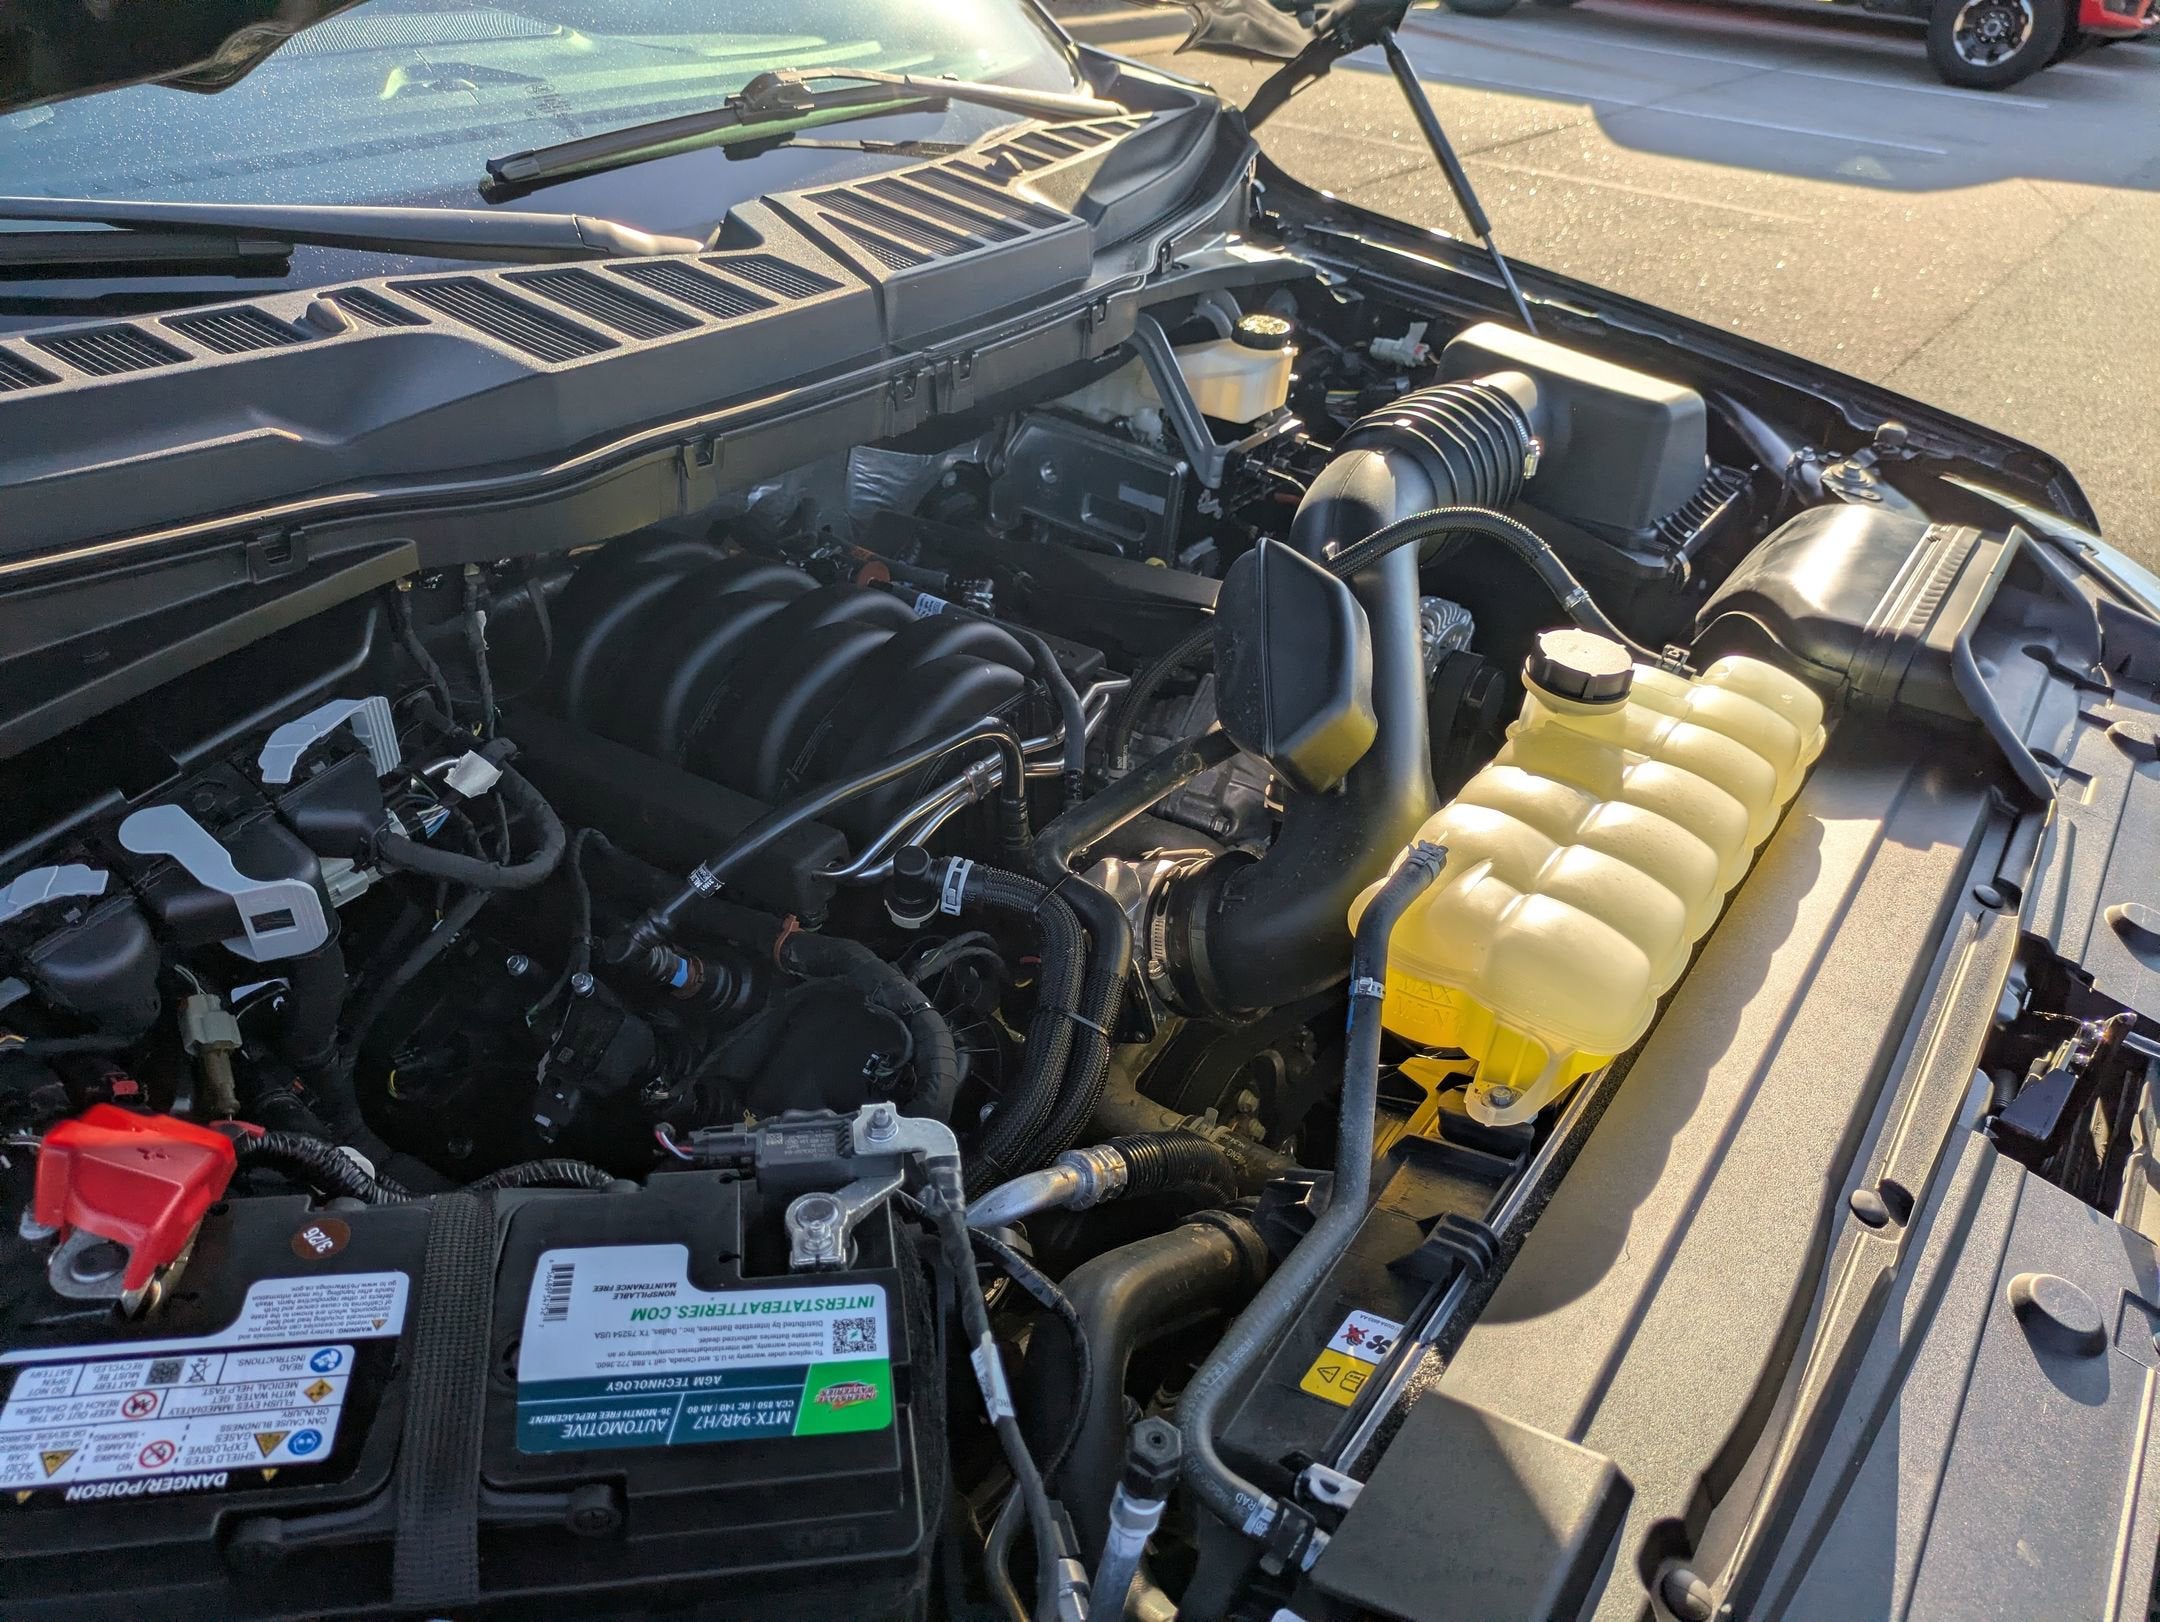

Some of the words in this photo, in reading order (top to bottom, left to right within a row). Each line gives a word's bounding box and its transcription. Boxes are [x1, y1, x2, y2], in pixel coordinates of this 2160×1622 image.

[303, 1227, 334, 1253] 3/26
[592, 1283, 613, 1292] FREE
[615, 1280, 677, 1291] MAINTENANCE
[326, 1287, 355, 1296] handling.
[612, 1289, 675, 1300] NONSPILLABLE
[251, 1293, 291, 1302] information
[297, 1294, 339, 1304] reproductive
[351, 1299, 383, 1307] California
[327, 1307, 347, 1315] which
[349, 1304, 390, 1314] compounds,
[629, 1293, 875, 1323] INTERSTATEBATTERIES.COM
[313, 1314, 344, 1323] including
[346, 1312, 380, 1321] chemicals
[262, 1322, 287, 1332] expose
[303, 1320, 344, 1329] accessories
[696, 1323, 732, 1333] Batteries,
[734, 1322, 770, 1331] Interstate
[771, 1320, 781, 1329] by
[782, 1319, 823, 1328] Distributed
[309, 1326, 333, 1335] Battery
[336, 1324, 371, 1334] WARNING:
[612, 1329, 636, 1337] 75254
[651, 1327, 677, 1335] Dallas,
[252, 1331, 285, 1339] terminals
[593, 1331, 610, 1339] USA
[722, 1334, 757, 1343] authorized
[759, 1332, 789, 1340] Batteries
[791, 1330, 823, 1338] Interstate
[697, 1336, 720, 1344] dealer.
[755, 1341, 785, 1349] warranty,
[627, 1343, 739, 1358] interstatebatteries.com/warranty
[736, 1351, 765, 1359] warranty
[788, 1348, 813, 1357] replace
[237, 1353, 305, 1366] INSTRUCTIONS.
[667, 1355, 696, 1363] Canada,
[278, 1362, 303, 1371] READ
[96, 1373, 109, 1381] BE
[112, 1370, 140, 1380] MUST
[693, 1374, 721, 1385] AGM
[42, 1377, 69, 1386] OPEN
[91, 1379, 137, 1390] BATTERY
[256, 1380, 298, 1391] MEDICAL
[605, 1376, 689, 1391] TECHNOLOGY
[26, 1387, 48, 1395] NOT
[51, 1385, 66, 1393] DO
[201, 1386, 226, 1395] FAST.
[228, 1383, 253, 1393] HELP
[234, 1391, 268, 1401] WATER.
[271, 1389, 295, 1397] WITH
[212, 1394, 230, 1402] GET
[775, 1398, 793, 1407] CCA
[69, 1402, 83, 1410] OF
[85, 1399, 119, 1409] REACH
[236, 1400, 260, 1410] EYES
[263, 1398, 293, 1408] FLUSH
[719, 1402, 735, 1411] 140
[737, 1401, 750, 1409] RC
[756, 1400, 773, 1408] 850
[89, 1408, 116, 1417] KEEP
[167, 1402, 234, 1416] IMMEDIATELY
[281, 1407, 314, 1418] INJURY.
[316, 1407, 328, 1415] OR
[622, 1406, 671, 1417] 36-MONTH
[686, 1404, 698, 1413] 80
[700, 1404, 712, 1412] Ah
[25, 1414, 46, 1423] THE
[48, 1413, 64, 1421] OF
[66, 1411, 87, 1419] OUT
[527, 1411, 597, 1423] REPLACEMENT
[599, 1410, 621, 1419] FREE
[692, 1409, 790, 1429] MTX-94R/H7
[274, 1418, 304, 1427] CAUSE
[306, 1416, 327, 1425] CAN
[220, 1420, 272, 1432] BLINDNESS
[559, 1417, 668, 1437] AUTOMOTIVE
[37, 1430, 69, 1439] SEVERE
[92, 1431, 138, 1441] SMOKING
[214, 1431, 251, 1442] GASES
[51, 1439, 82, 1448] CAUSE
[95, 1440, 136, 1451] FLAMES
[186, 1441, 248, 1455] EXPLOSIVE
[214, 1451, 256, 1463] SHIELD
[5, 1462, 33, 1470] ACID
[116, 1463, 133, 1471] NO
[64, 1471, 228, 1500] DANGER/POISON
[1235, 1492, 1257, 1511] RAD
